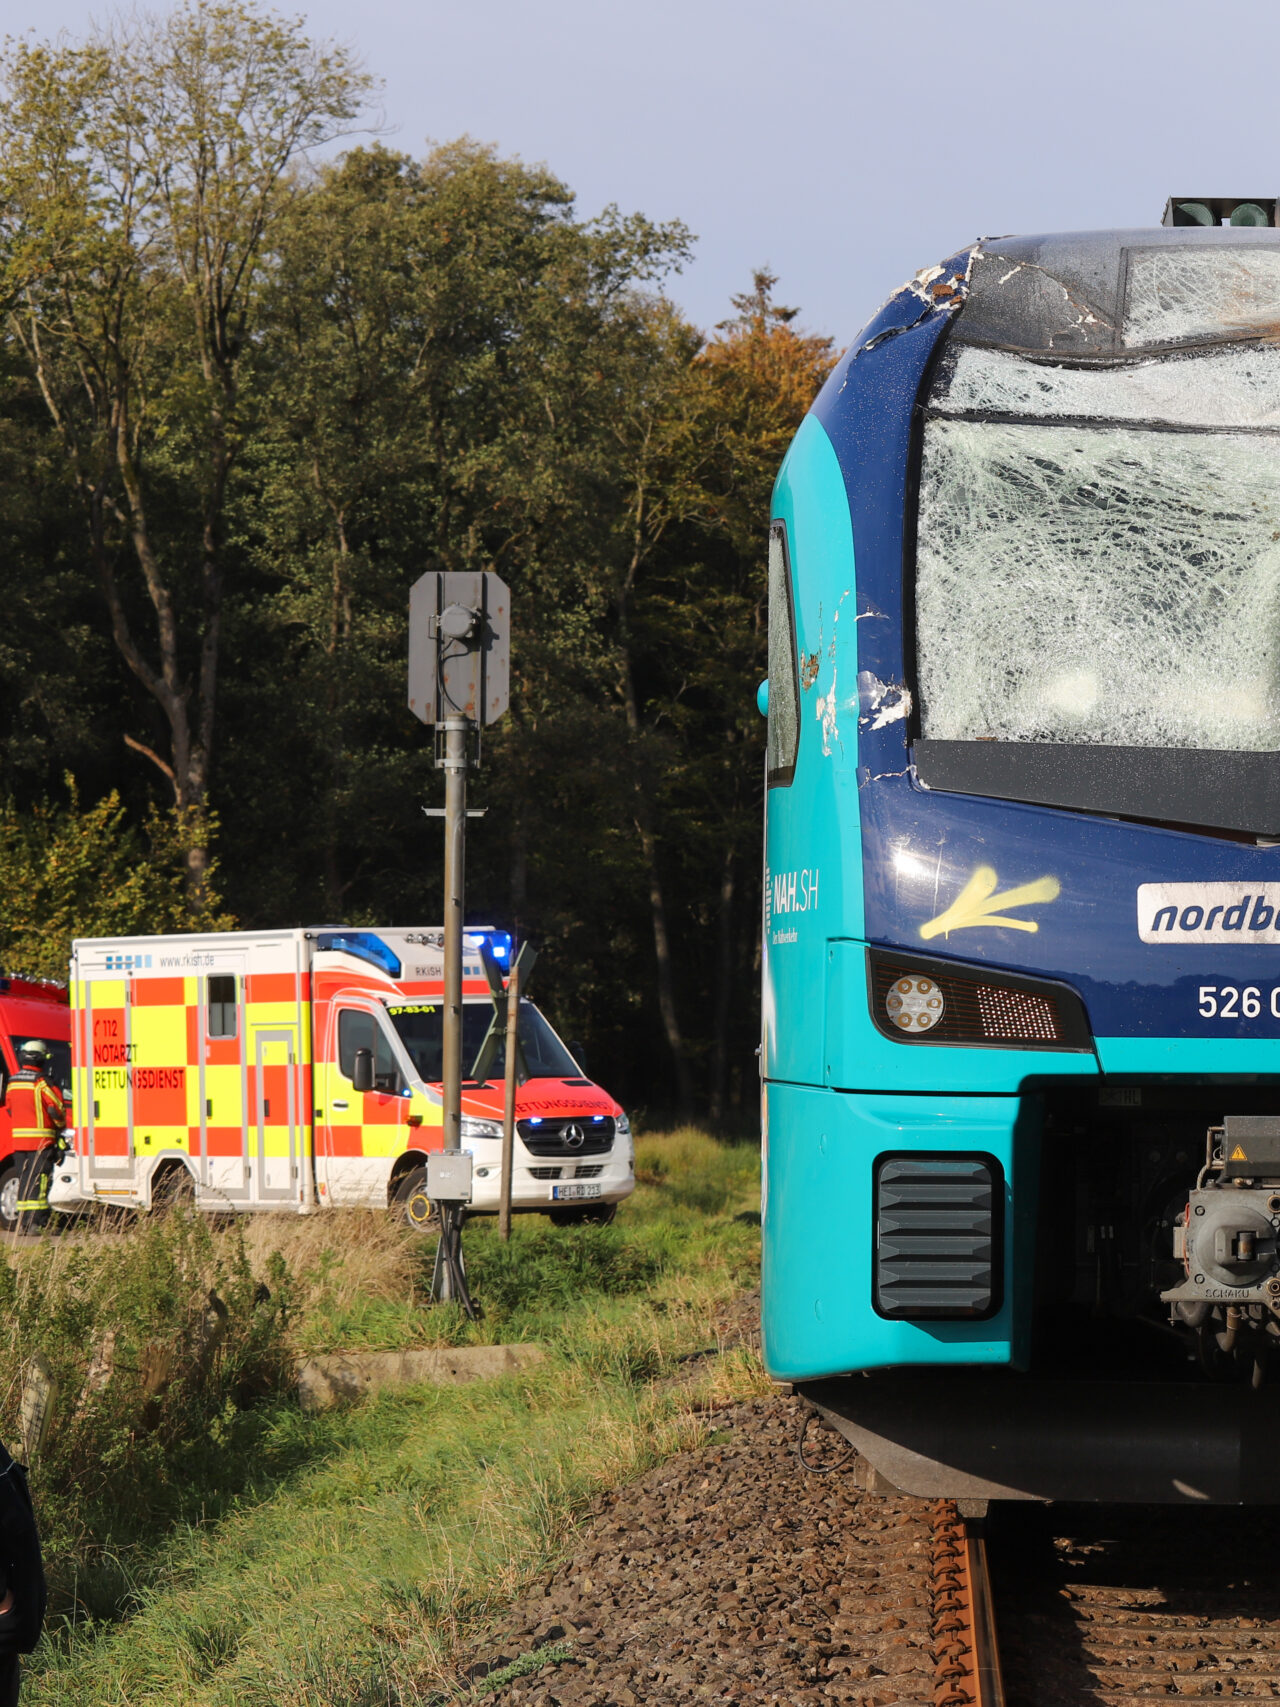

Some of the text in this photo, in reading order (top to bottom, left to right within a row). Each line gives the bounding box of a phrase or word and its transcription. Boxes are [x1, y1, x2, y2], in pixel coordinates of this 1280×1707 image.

[773, 869, 819, 914] NAH.SH
[160, 953, 214, 967] www.rkish.de
[1198, 986, 1261, 1018] 526
[103, 1019, 118, 1037] 112
[94, 1043, 138, 1062] NOTARZT
[94, 1069, 184, 1090] RETTUNGSDIENST
[1205, 1288, 1250, 1298] SCHAKU
